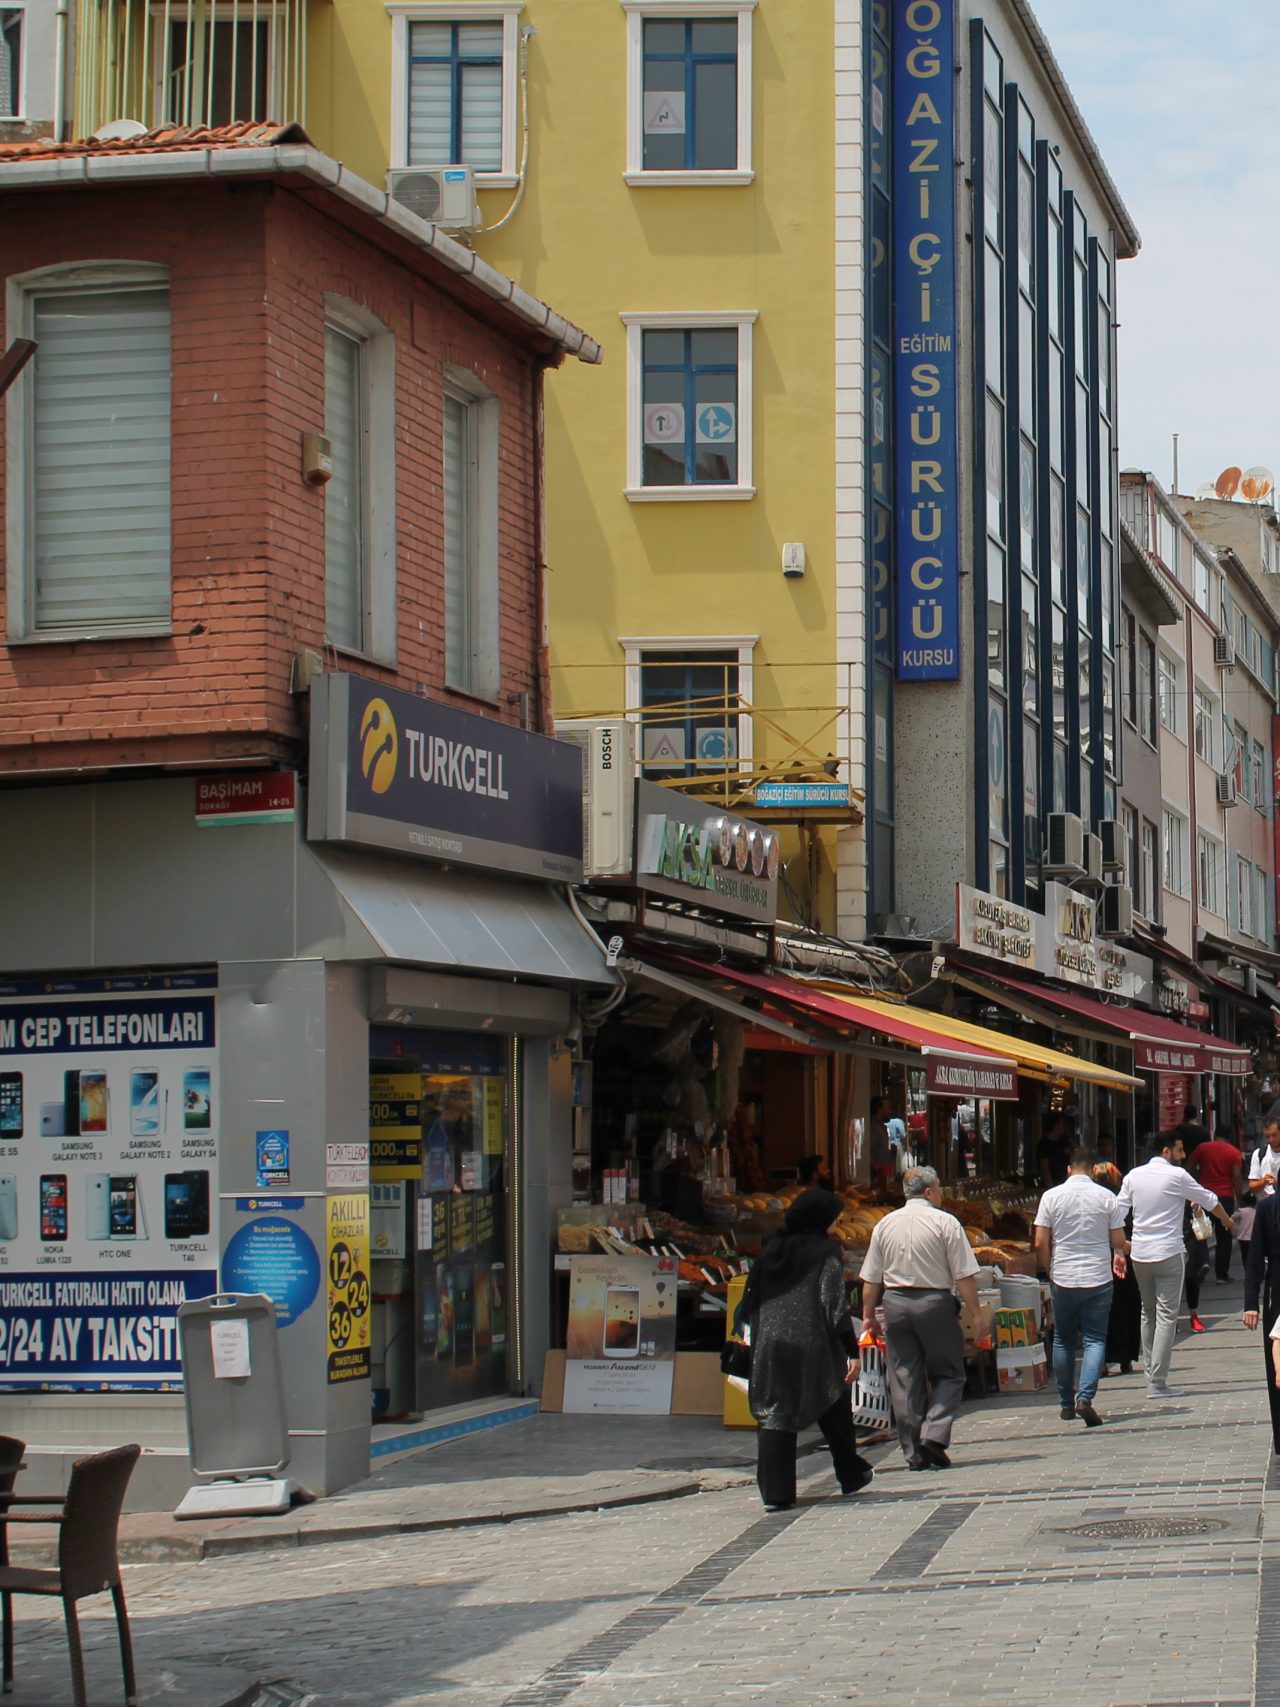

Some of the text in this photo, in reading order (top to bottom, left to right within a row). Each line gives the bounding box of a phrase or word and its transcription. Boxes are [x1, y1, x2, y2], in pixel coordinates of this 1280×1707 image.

[900, 333, 952, 354] EĞİTİM
[910, 363, 945, 640] SÜRÜCÜ
[902, 648, 955, 667] KURSU
[601, 728, 613, 770] BOSCH
[405, 728, 510, 801] TURKCELL
[200, 780, 263, 799] BAŞİMAM
[21, 1018, 61, 1048] CEP
[67, 1011, 204, 1046] TELEFONLARI
[331, 1199, 366, 1222] AKILLI
[98, 1249, 131, 1259] HTC ONE
[169, 1243, 207, 1253] TURKCELL
[182, 1254, 195, 1263] T40
[331, 1252, 352, 1281] 12
[55, 1281, 110, 1308] FATURALI
[111, 1281, 145, 1307] HATTI
[147, 1280, 187, 1306] OLANA
[349, 1280, 369, 1309] 24
[50, 1317, 83, 1362] AY
[331, 1312, 352, 1340] 36
[610, 1362, 640, 1371] Ascend
